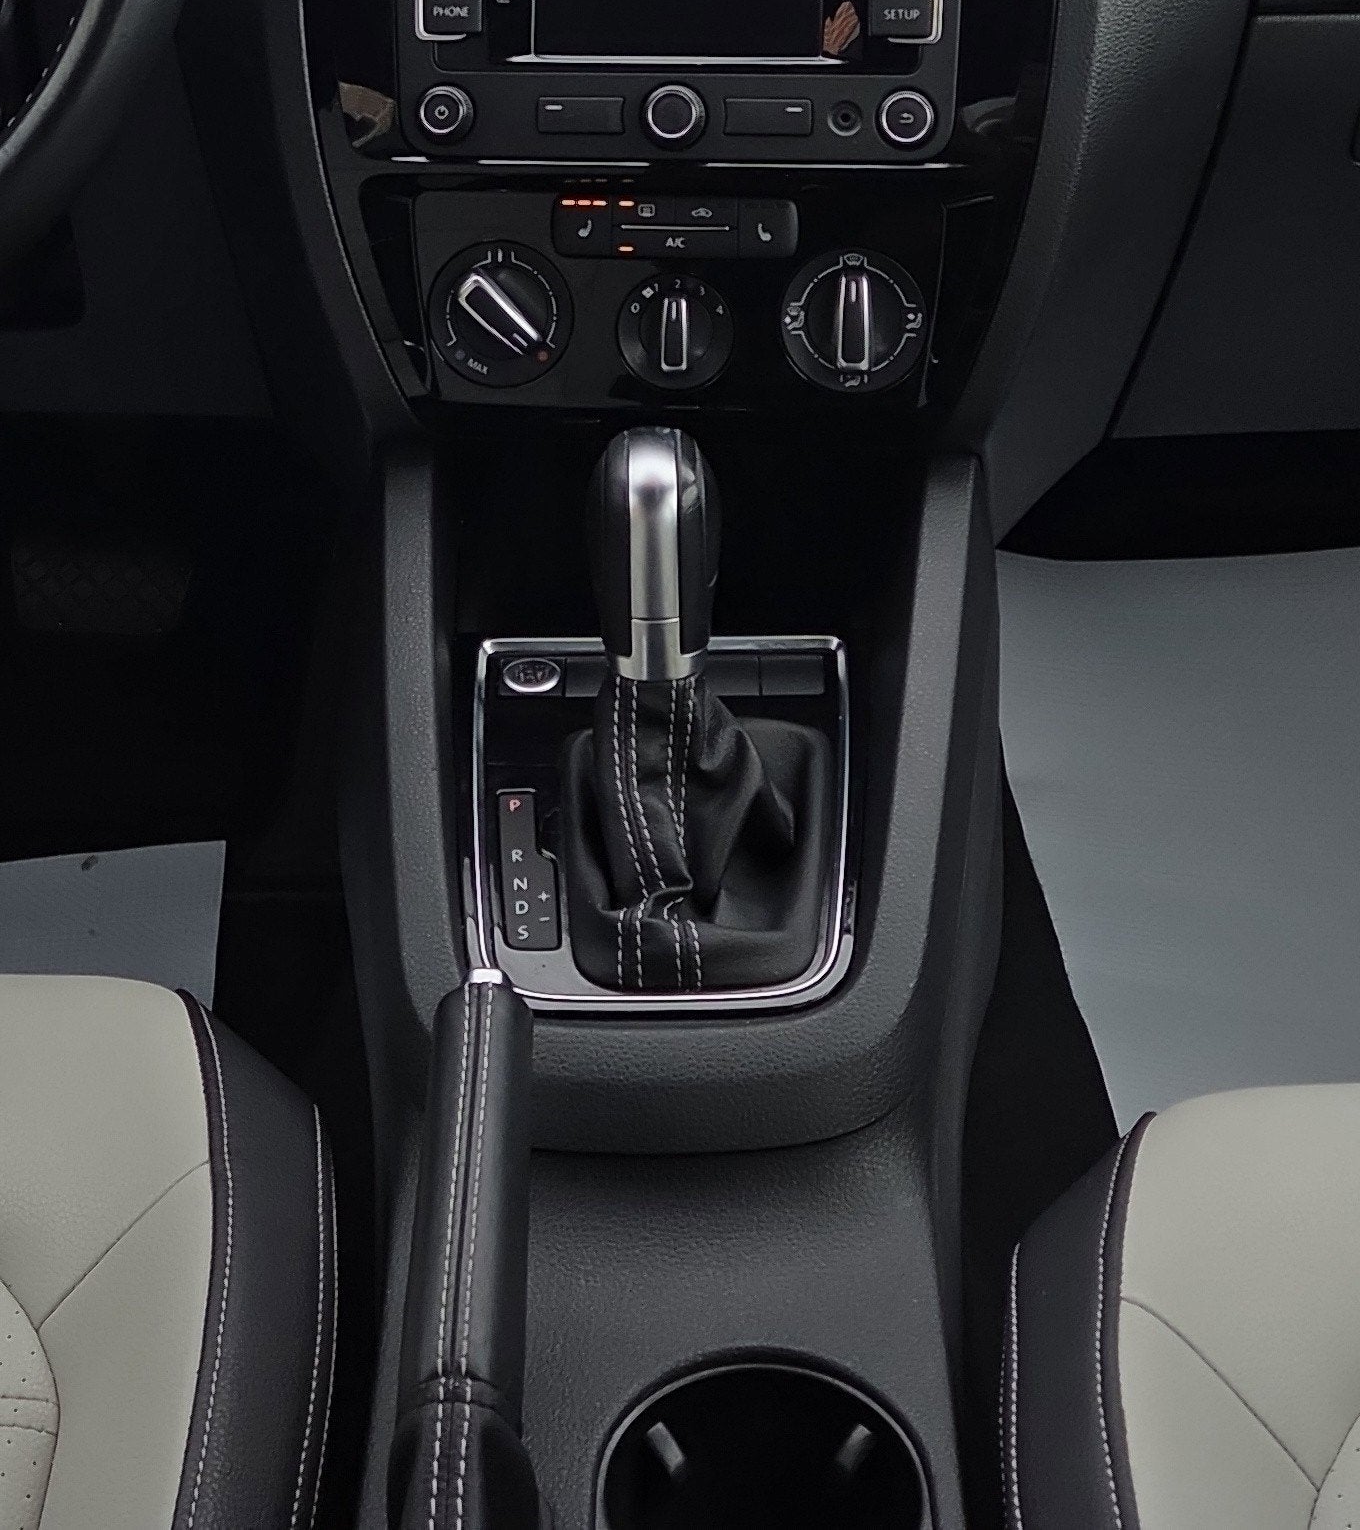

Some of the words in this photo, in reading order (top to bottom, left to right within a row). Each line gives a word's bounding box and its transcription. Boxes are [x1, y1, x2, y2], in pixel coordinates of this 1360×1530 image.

[432, 5, 469, 17] PHONE
[883, 9, 921, 20] SETUP
[665, 237, 686, 248] A/C
[467, 358, 488, 375] MAX
[509, 799, 521, 812] P
[511, 849, 523, 863] R
[513, 877, 528, 891] N
[515, 900, 529, 914] D
[517, 925, 529, 940] S
